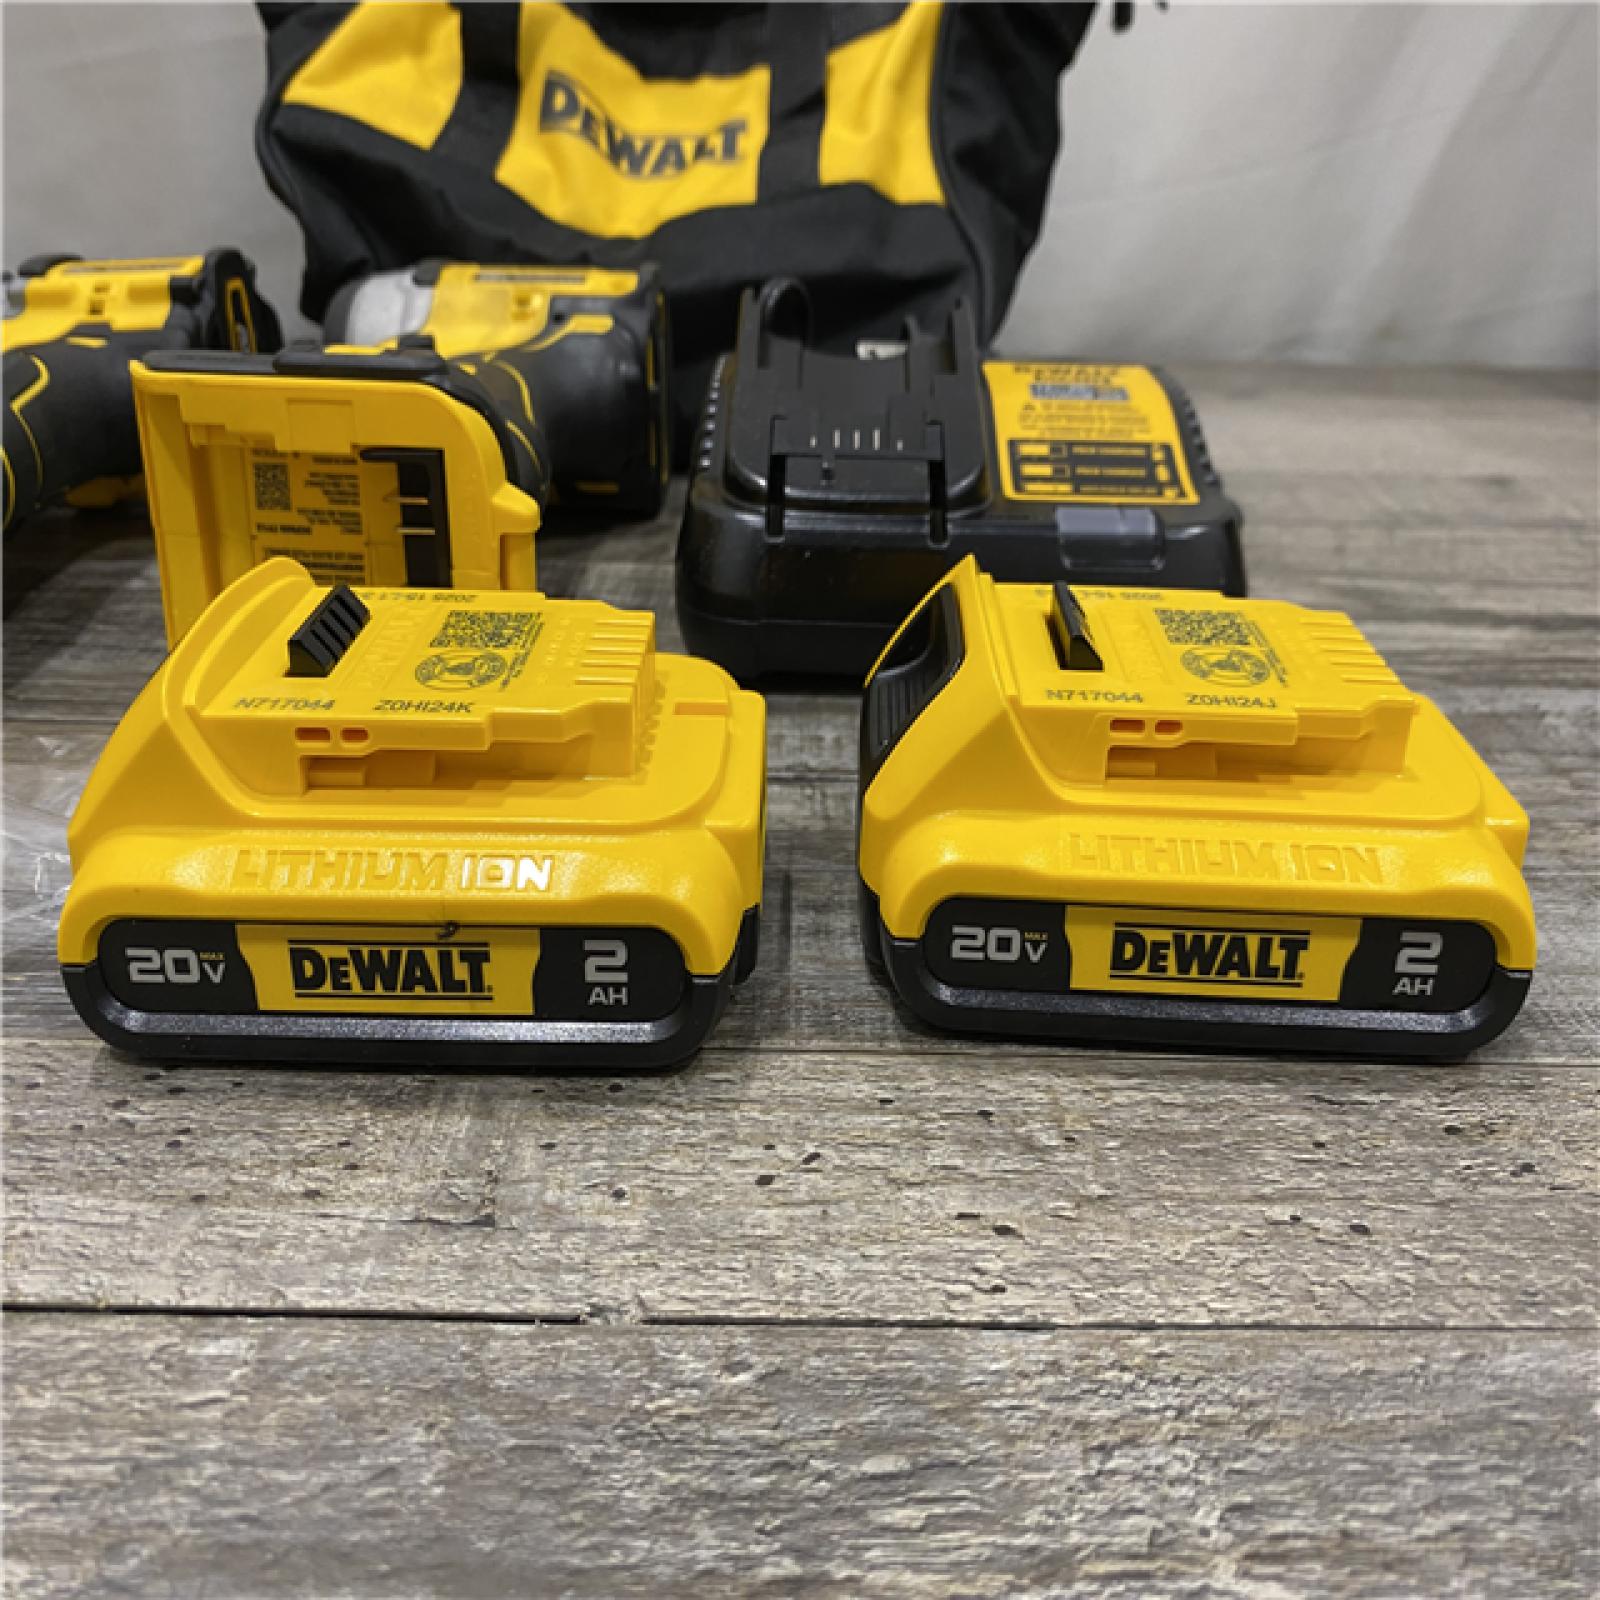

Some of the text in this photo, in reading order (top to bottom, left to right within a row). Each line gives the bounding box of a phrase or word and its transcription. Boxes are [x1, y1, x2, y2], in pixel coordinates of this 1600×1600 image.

[540, 70, 749, 176] DEWALT
[234, 697, 336, 711] N717044
[1046, 689, 1144, 705] N717044
[230, 849, 553, 892] LITHIUM ION
[1062, 832, 1384, 885] LITHIUM ION
[288, 946, 493, 994] DEWALT
[583, 939, 629, 984] 2
[1110, 929, 1309, 981] DEWALT
[1394, 931, 1444, 975] 2
[586, 986, 629, 1006] AH
[1391, 976, 1435, 996] AH
